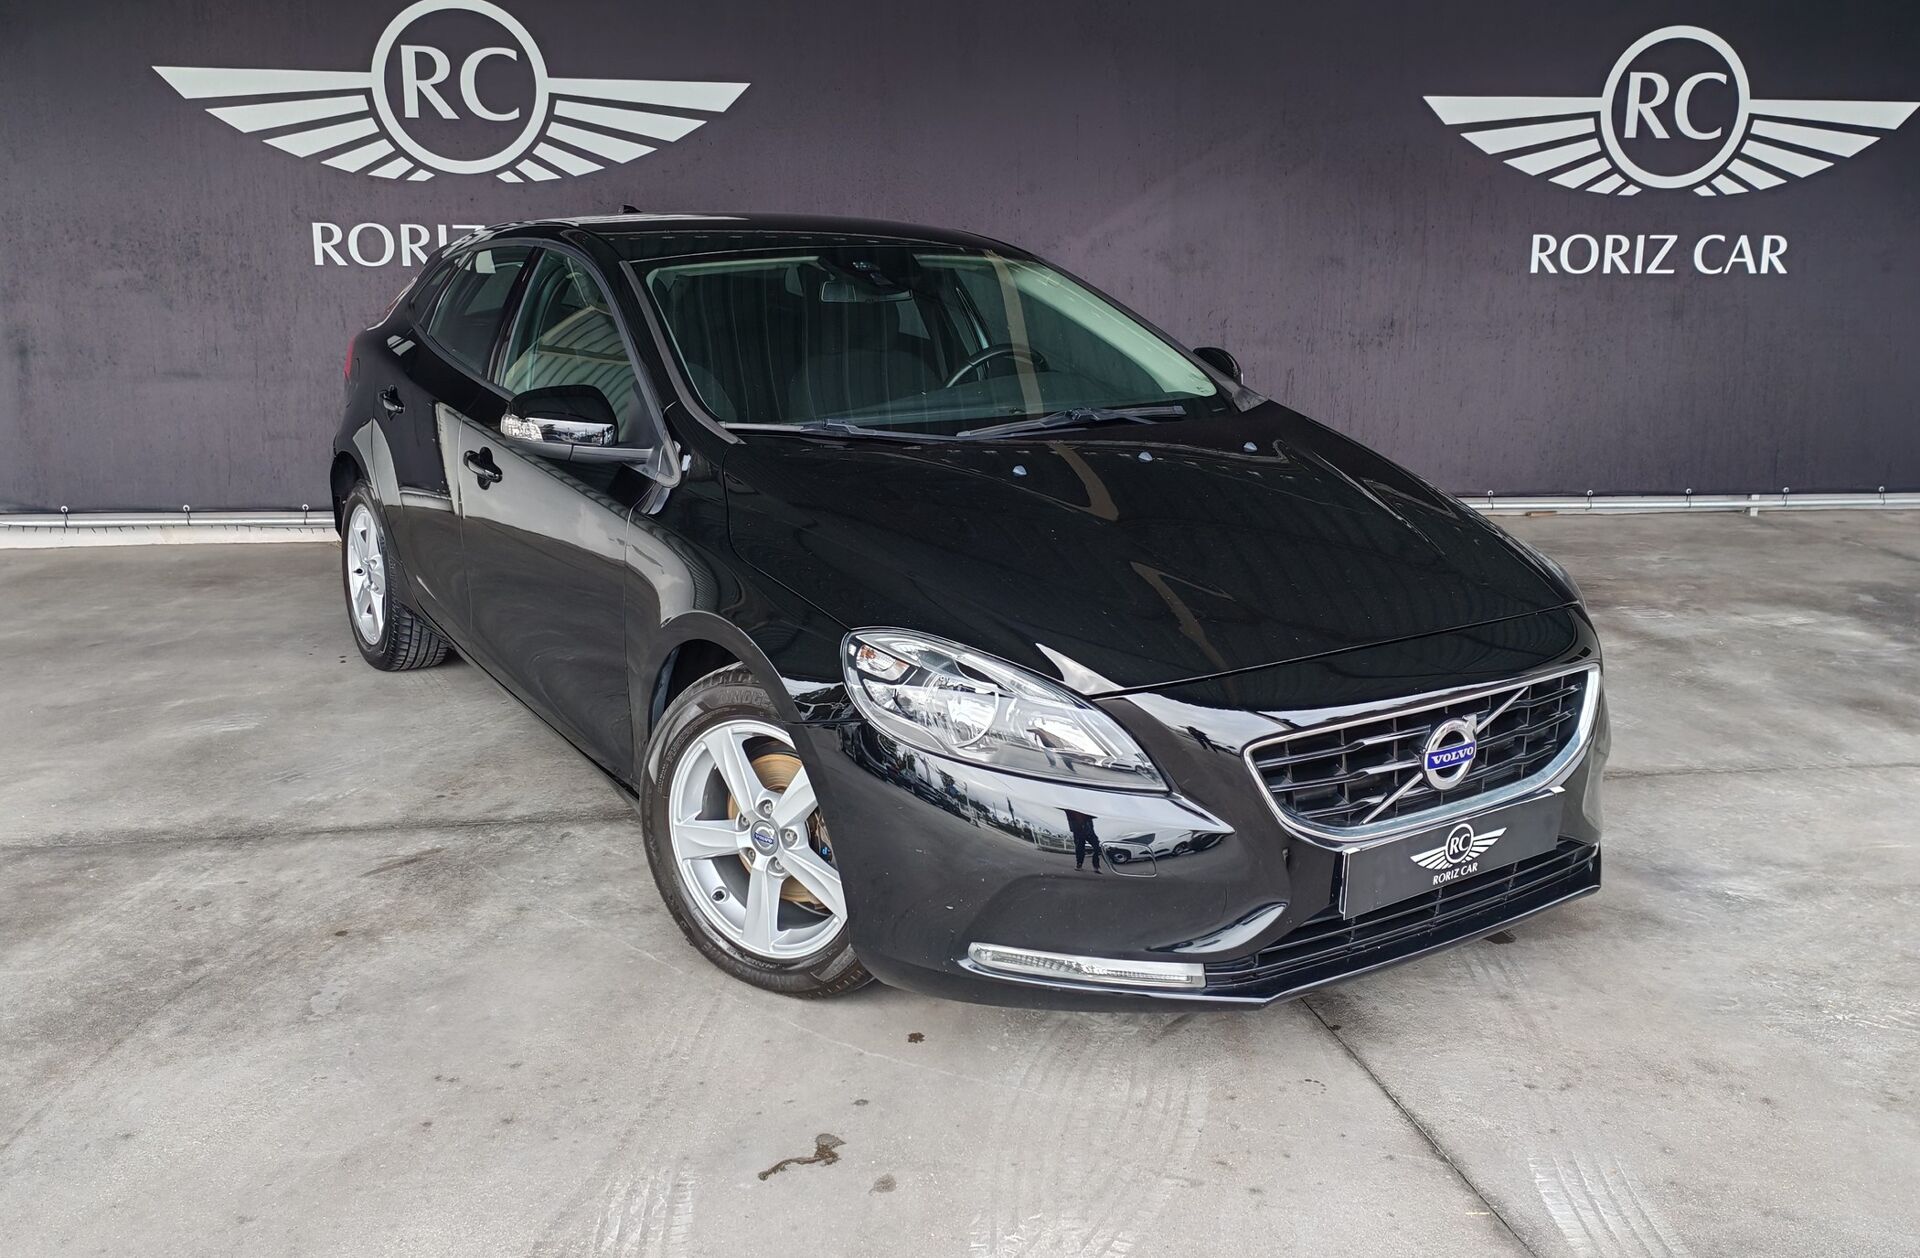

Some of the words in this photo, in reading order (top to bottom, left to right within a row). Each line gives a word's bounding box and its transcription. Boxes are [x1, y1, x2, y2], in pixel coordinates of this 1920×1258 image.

[400, 44, 520, 121] RC
[1623, 71, 1728, 141] RC
[312, 222, 485, 267] RORI
[1529, 233, 1679, 275] RORIZ
[1693, 234, 1788, 275] CAR
[1431, 746, 1474, 764] VOLVO
[1449, 833, 1470, 855] RC
[1432, 868, 1460, 885] RORIZ
[1460, 862, 1478, 875] CAR
